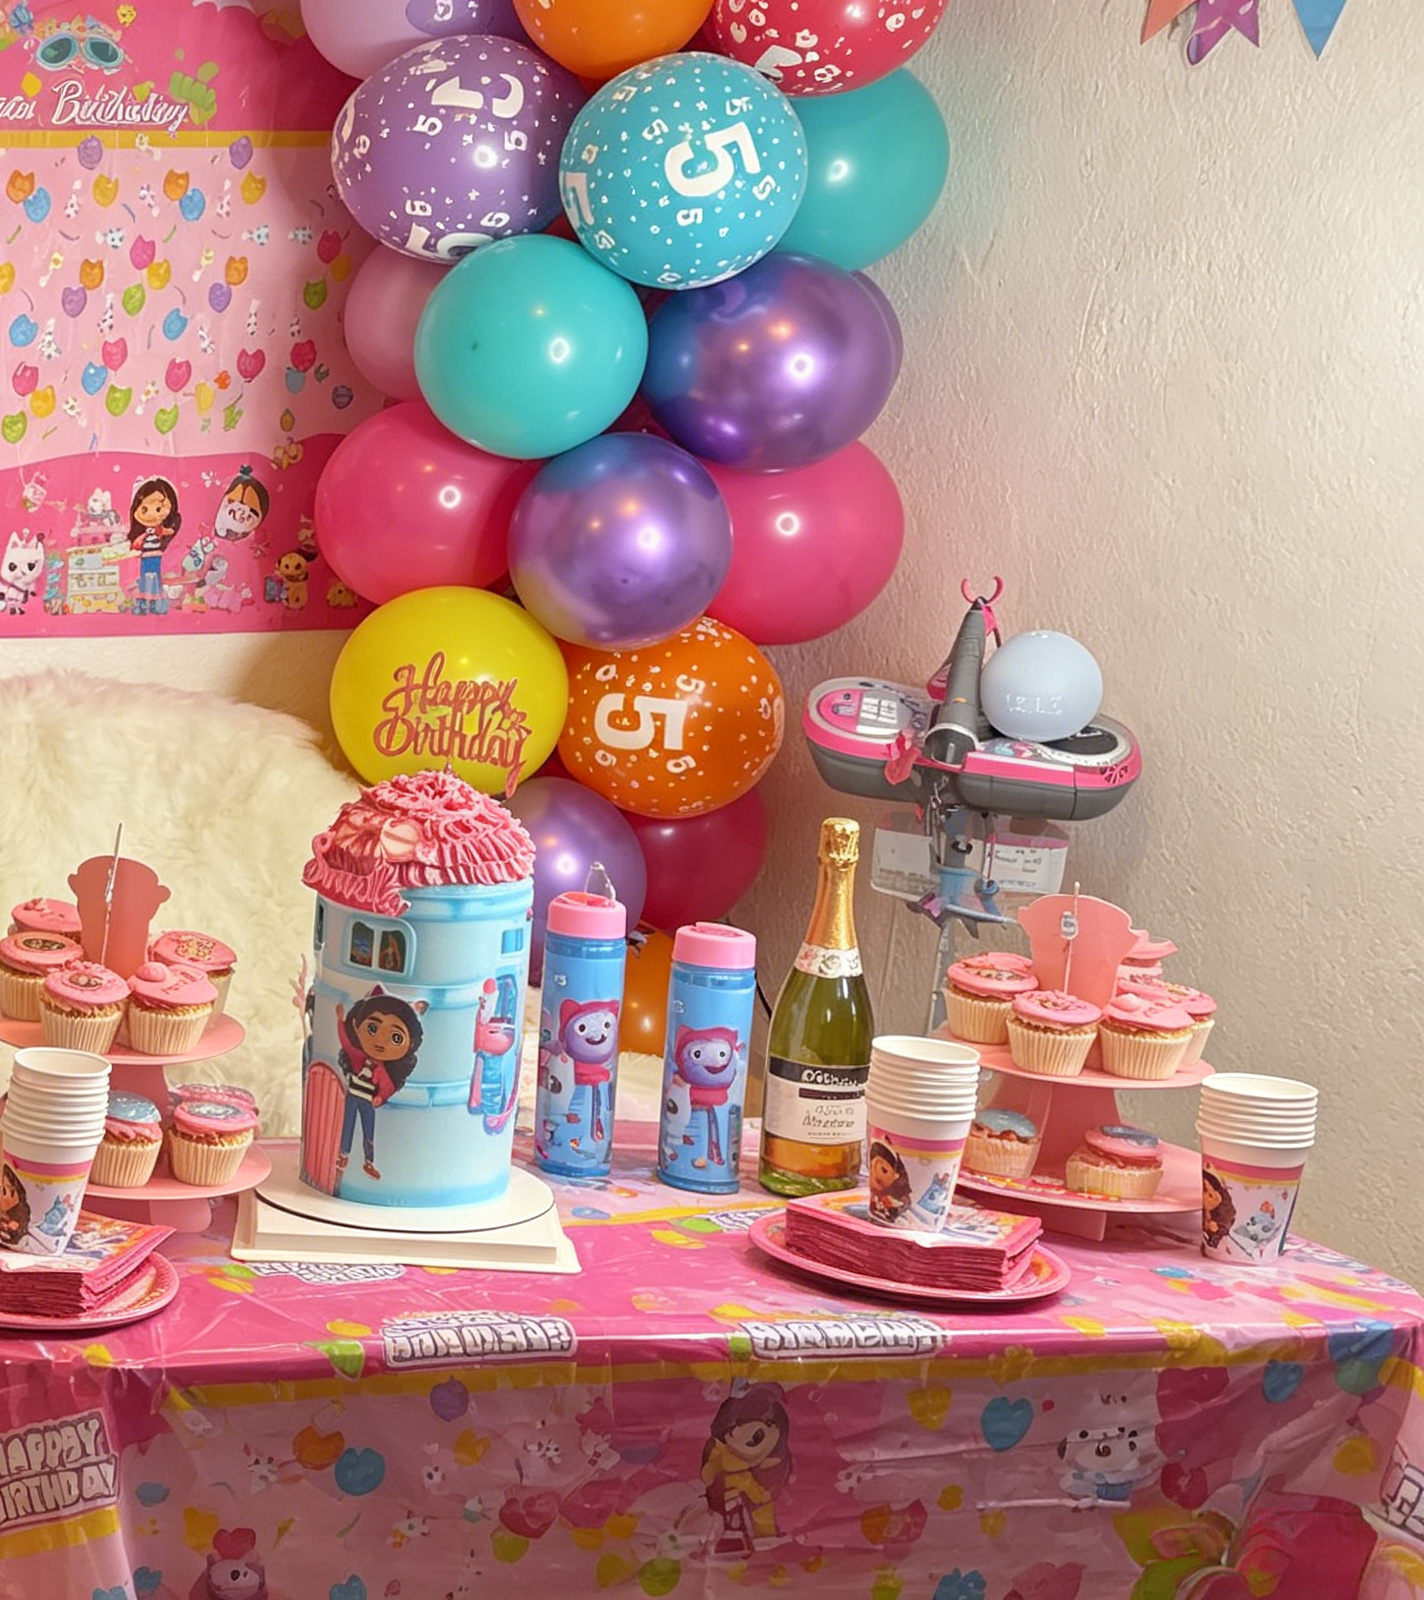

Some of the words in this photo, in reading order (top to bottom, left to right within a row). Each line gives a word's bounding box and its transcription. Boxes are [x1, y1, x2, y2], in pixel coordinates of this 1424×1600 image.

[663, 121, 761, 197] 5
[382, 650, 518, 733] Happy
[594, 692, 688, 751] 5
